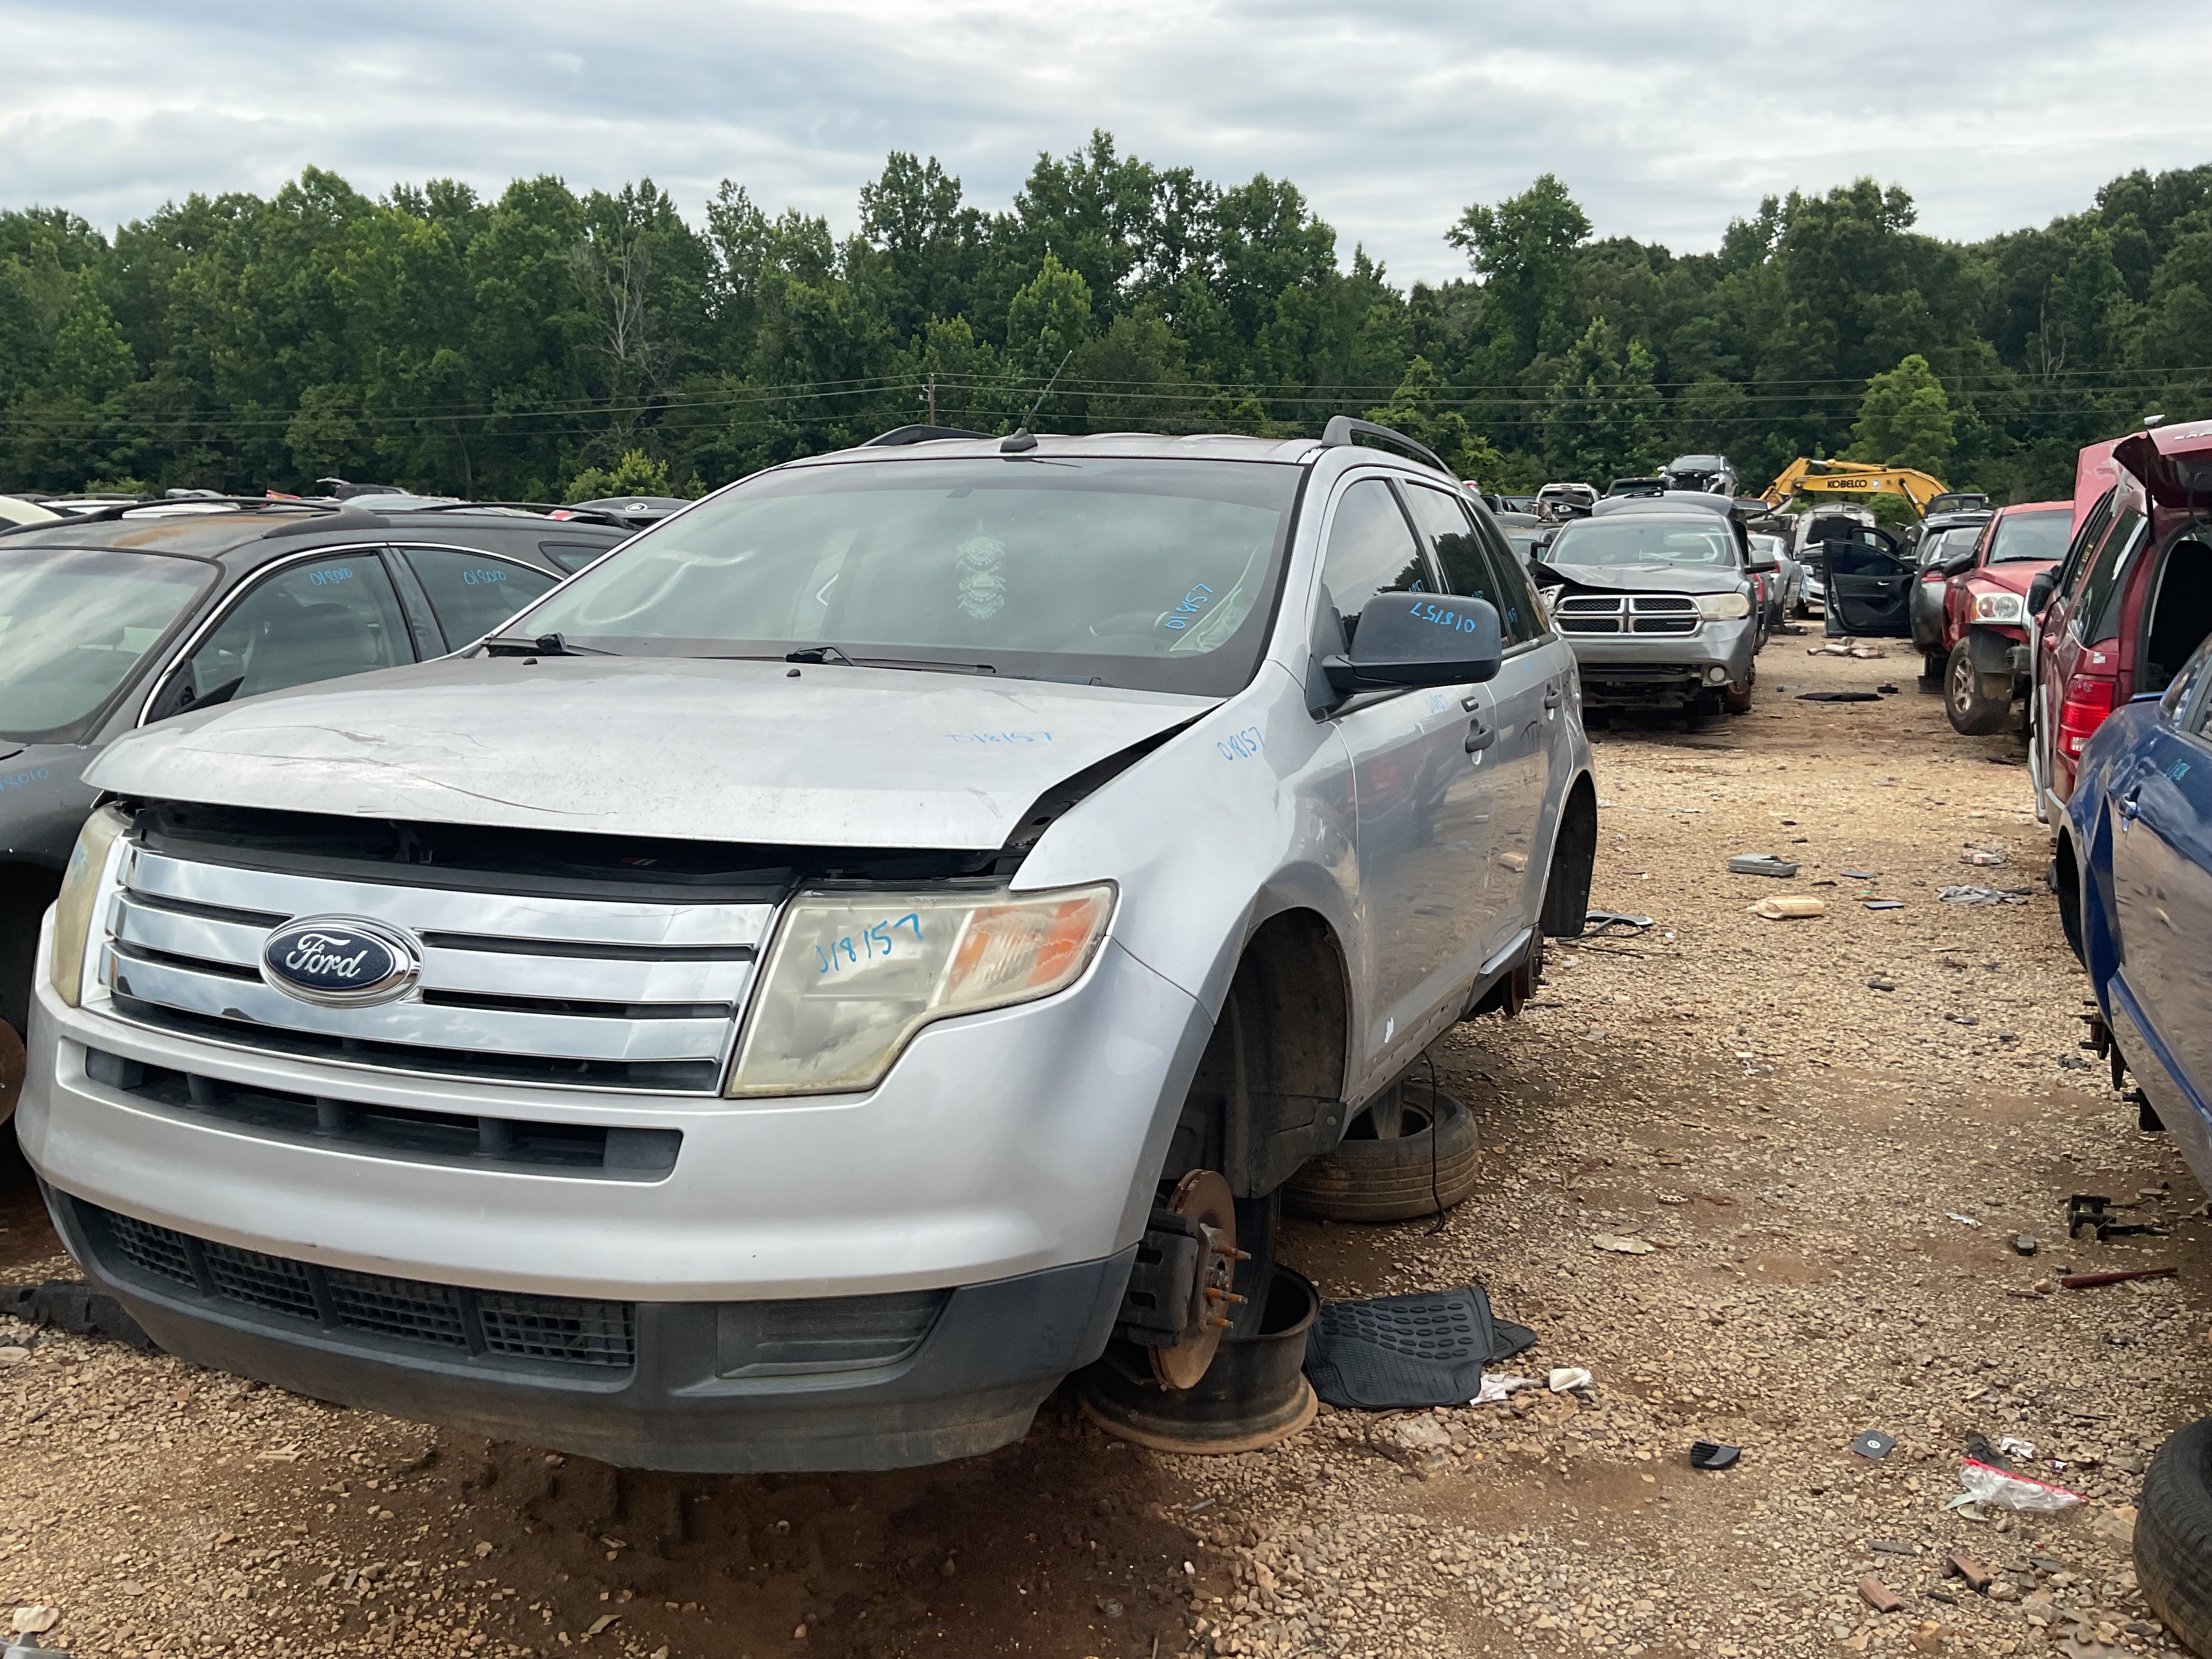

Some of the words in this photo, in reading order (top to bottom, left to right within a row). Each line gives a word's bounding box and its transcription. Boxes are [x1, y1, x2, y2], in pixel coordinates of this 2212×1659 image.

[1827, 479, 1867, 488] KOBELCO
[464, 569, 506, 584] 018010
[1217, 726, 1265, 760] 018157
[285, 933, 368, 978] Ford
